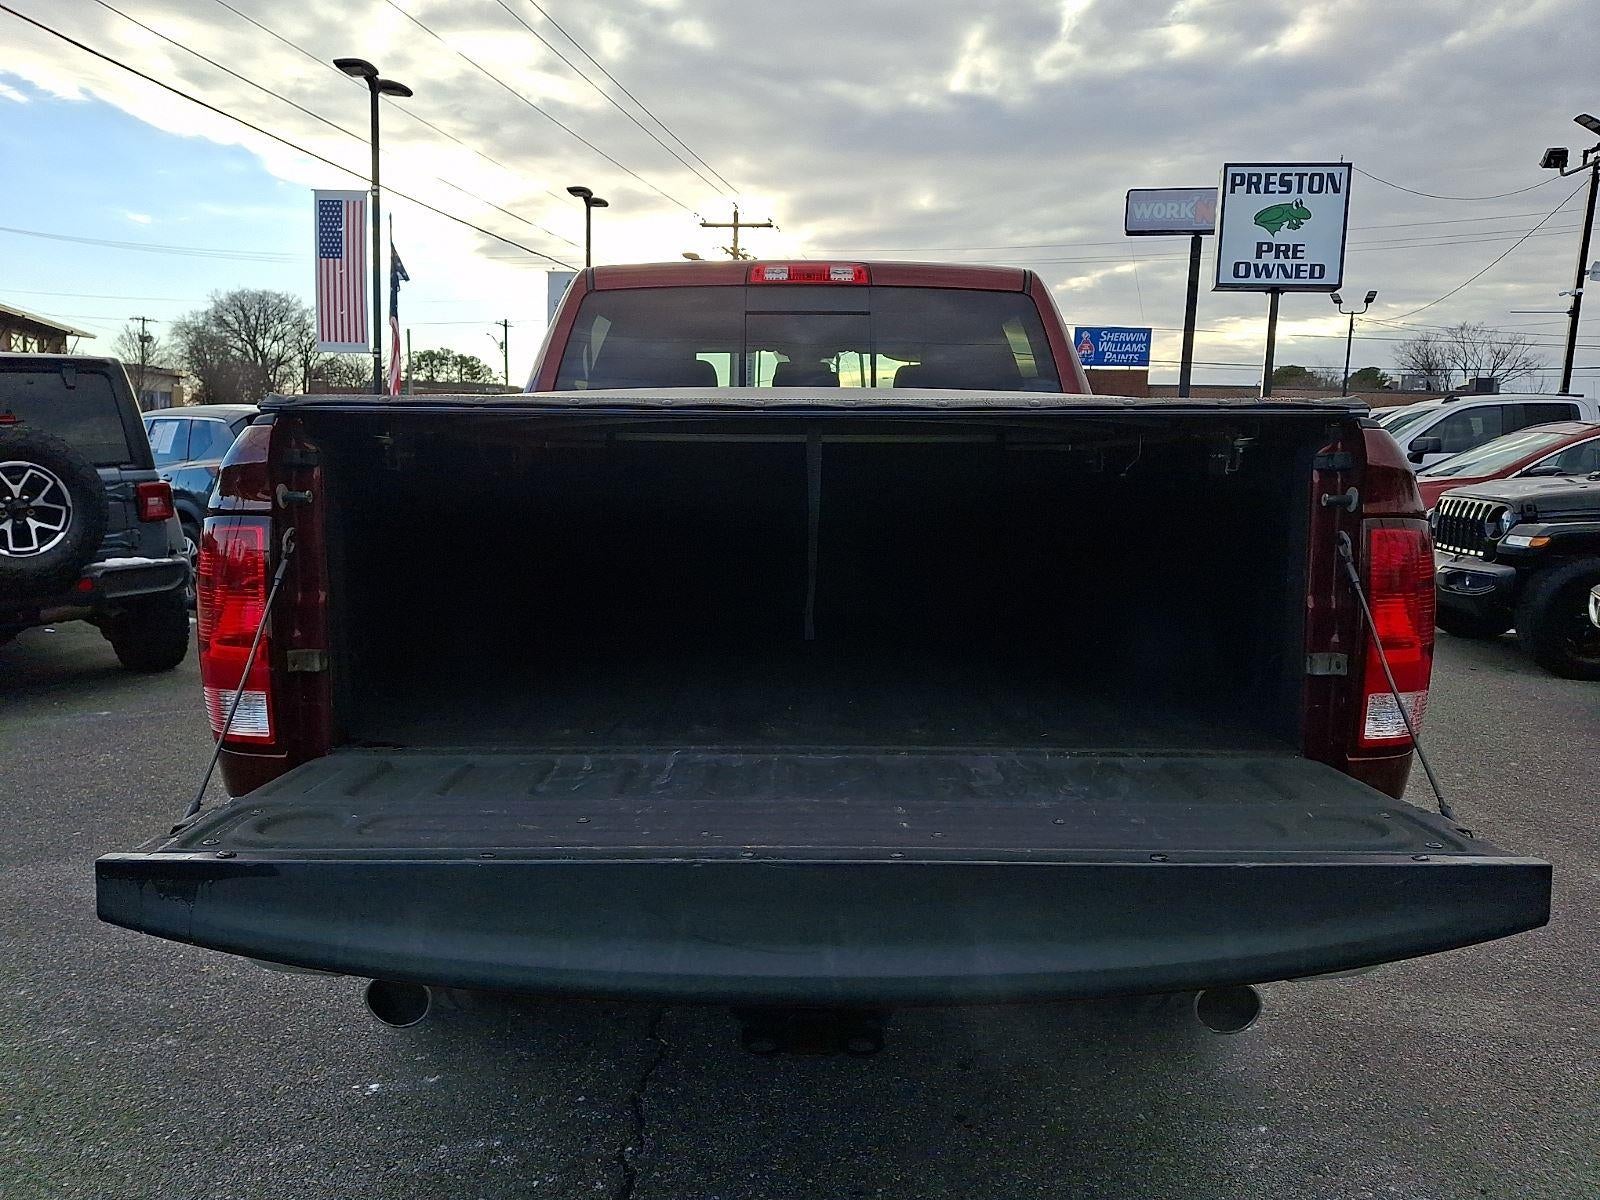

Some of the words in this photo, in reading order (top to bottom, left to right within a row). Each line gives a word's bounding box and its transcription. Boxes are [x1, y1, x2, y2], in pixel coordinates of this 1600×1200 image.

[1229, 172, 1343, 195] PRESTON
[1255, 241, 1306, 260] PRE
[1232, 261, 1326, 280] OWNED
[1100, 330, 1147, 342] SHERWIN
[1098, 341, 1147, 352] WILLIAMS
[1103, 351, 1140, 363] PAINTS
